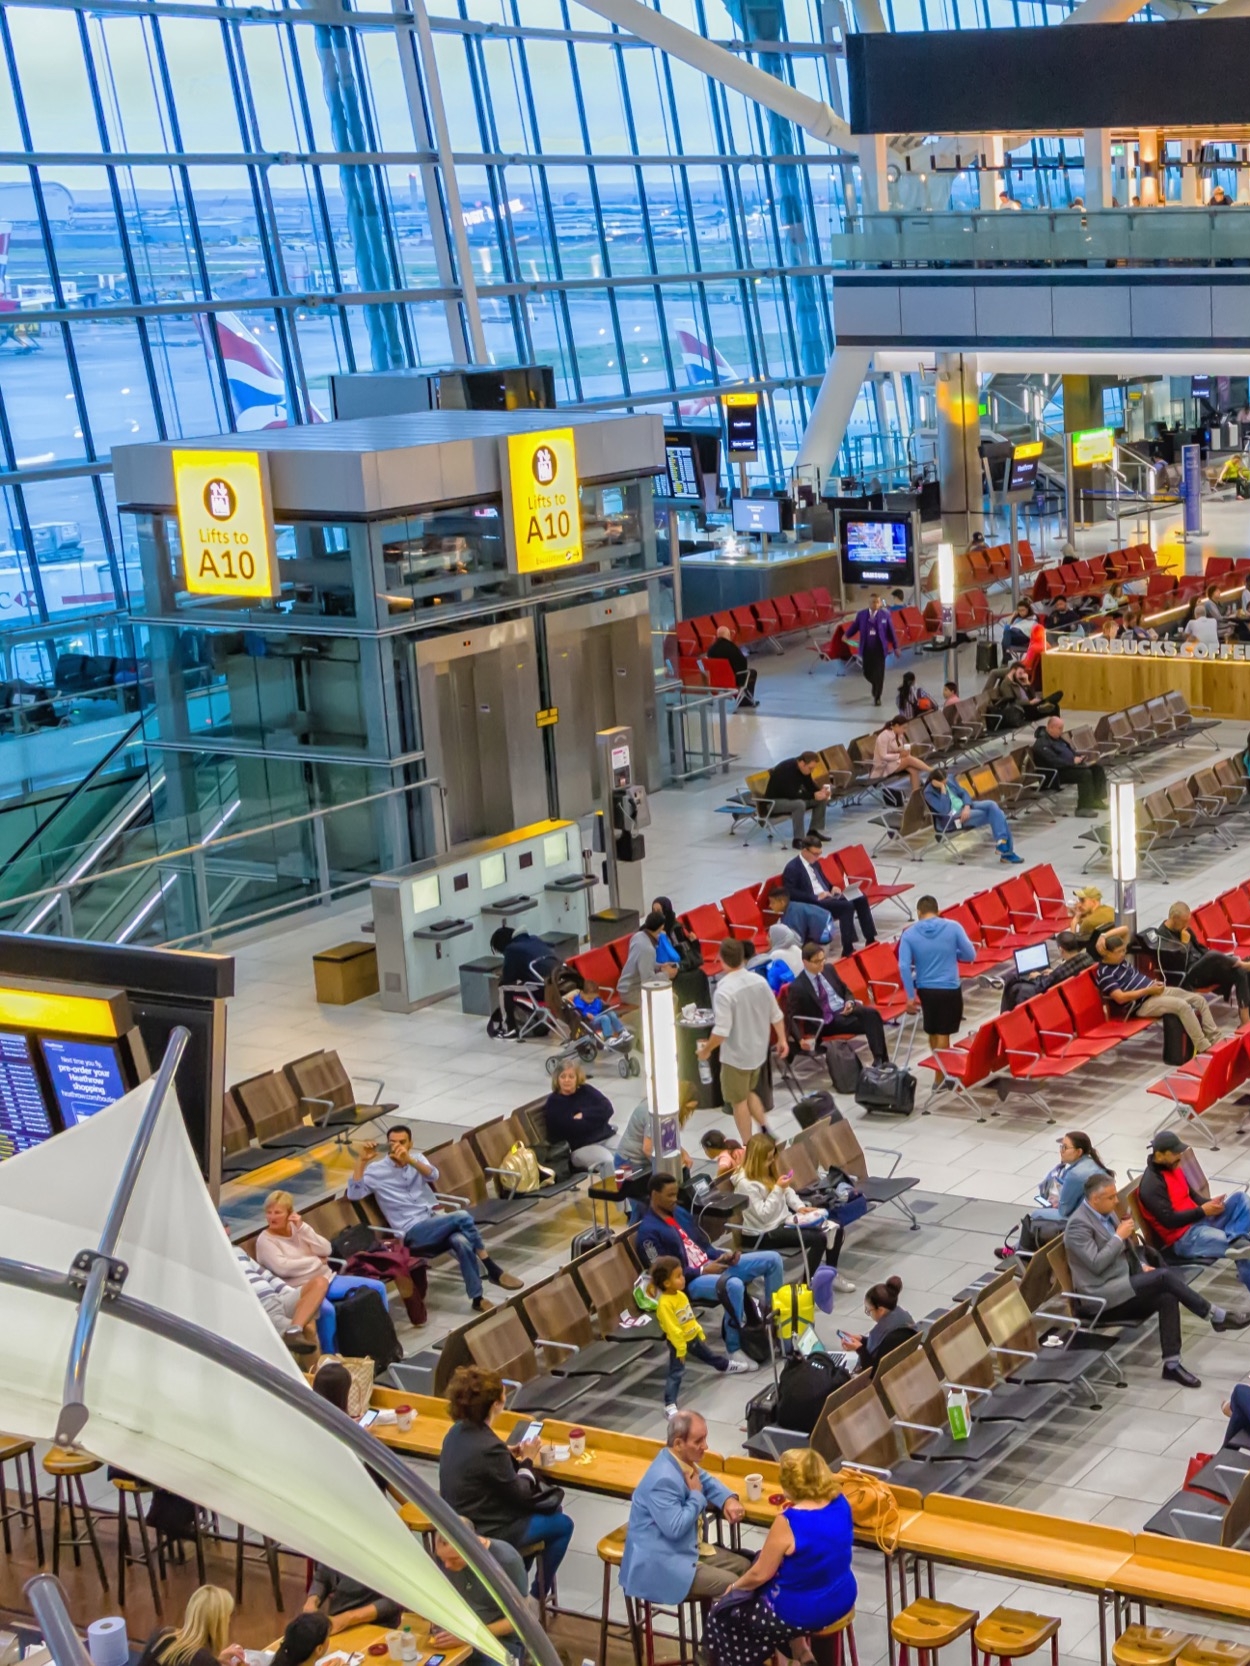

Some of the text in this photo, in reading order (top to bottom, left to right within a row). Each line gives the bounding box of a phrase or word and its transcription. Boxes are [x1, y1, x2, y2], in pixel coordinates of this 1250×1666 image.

[527, 493, 566, 510] Lifts to
[527, 510, 570, 544] A10
[199, 528, 249, 545] Lifts to
[199, 549, 255, 580] A10
[1057, 635, 1177, 658] STARBUCKS
[58, 1064, 110, 1078] pre-order your
[69, 1073, 104, 1086] Heathrow
[72, 1082, 106, 1095] shopping
